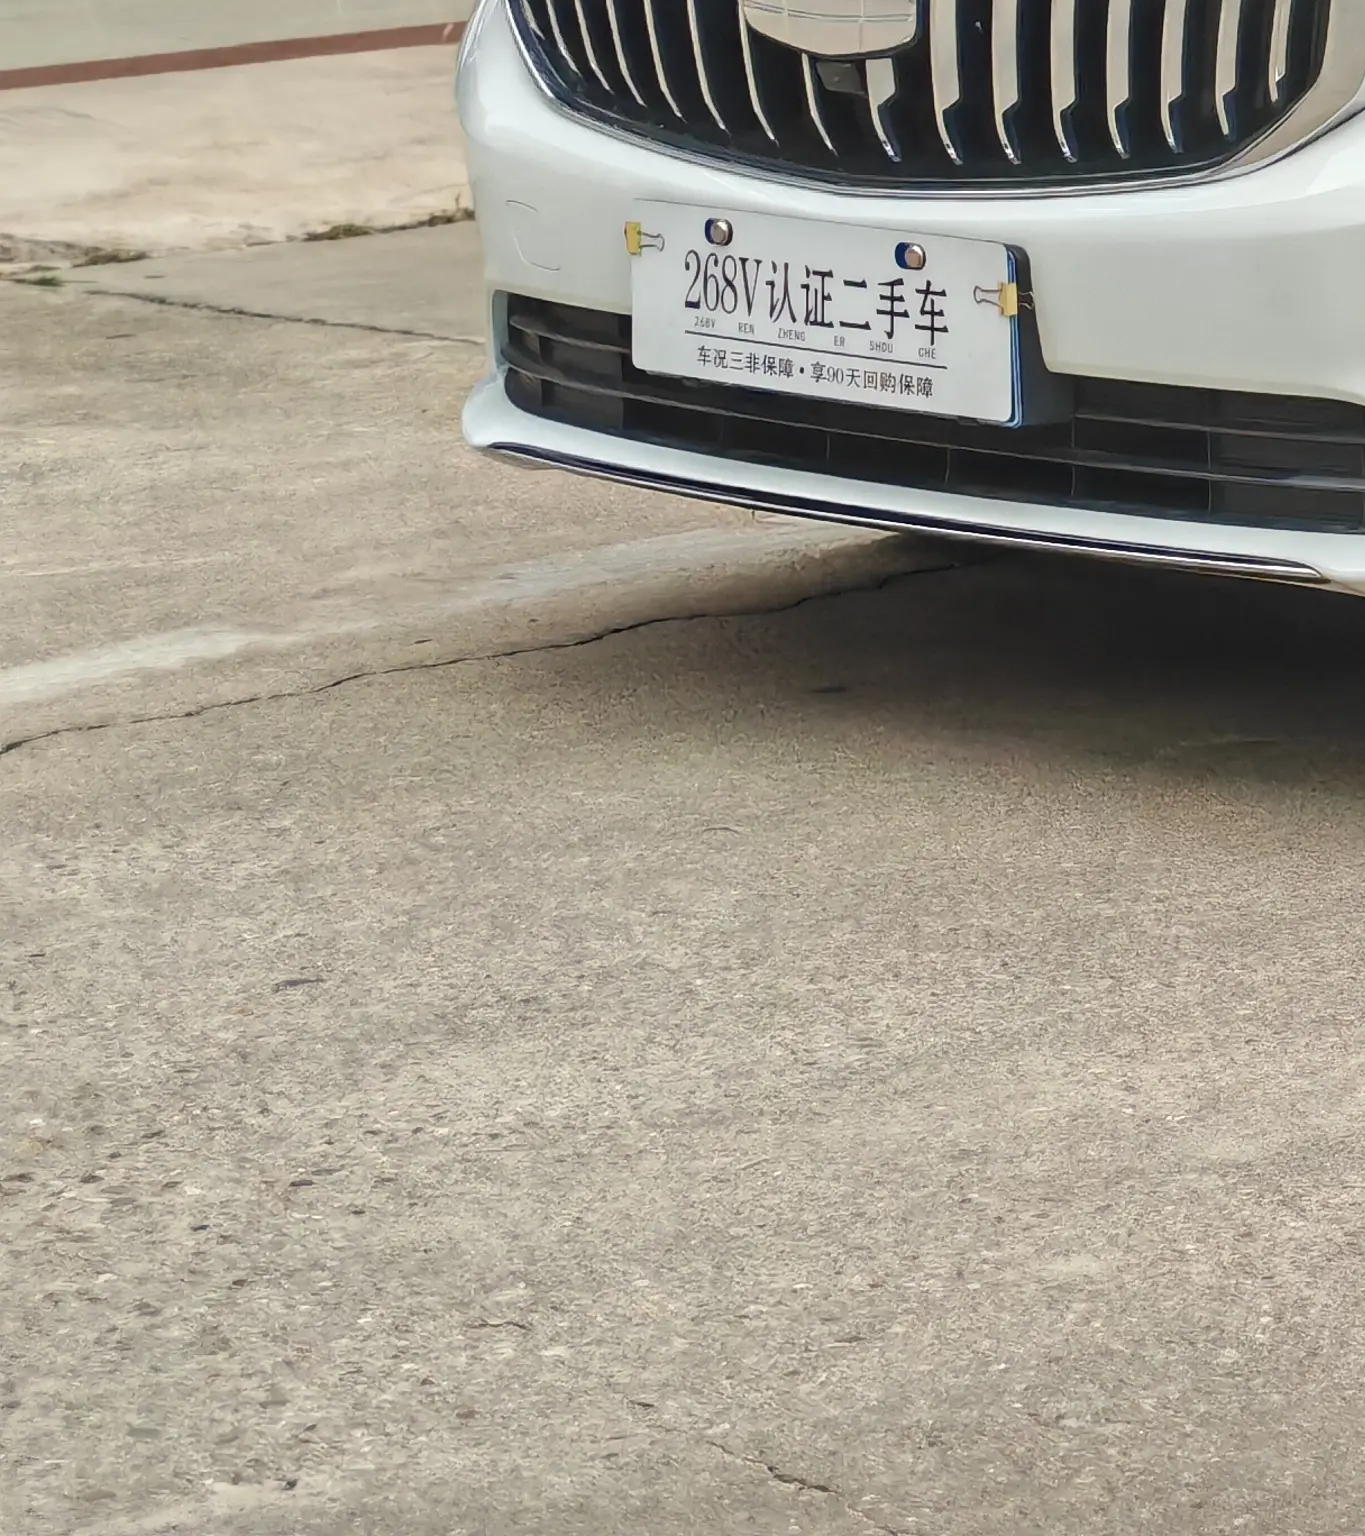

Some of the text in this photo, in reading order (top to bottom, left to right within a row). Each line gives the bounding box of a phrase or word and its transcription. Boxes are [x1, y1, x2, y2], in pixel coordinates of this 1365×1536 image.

[684, 249, 950, 347] 268V认证二手车
[738, 321, 755, 335] REN
